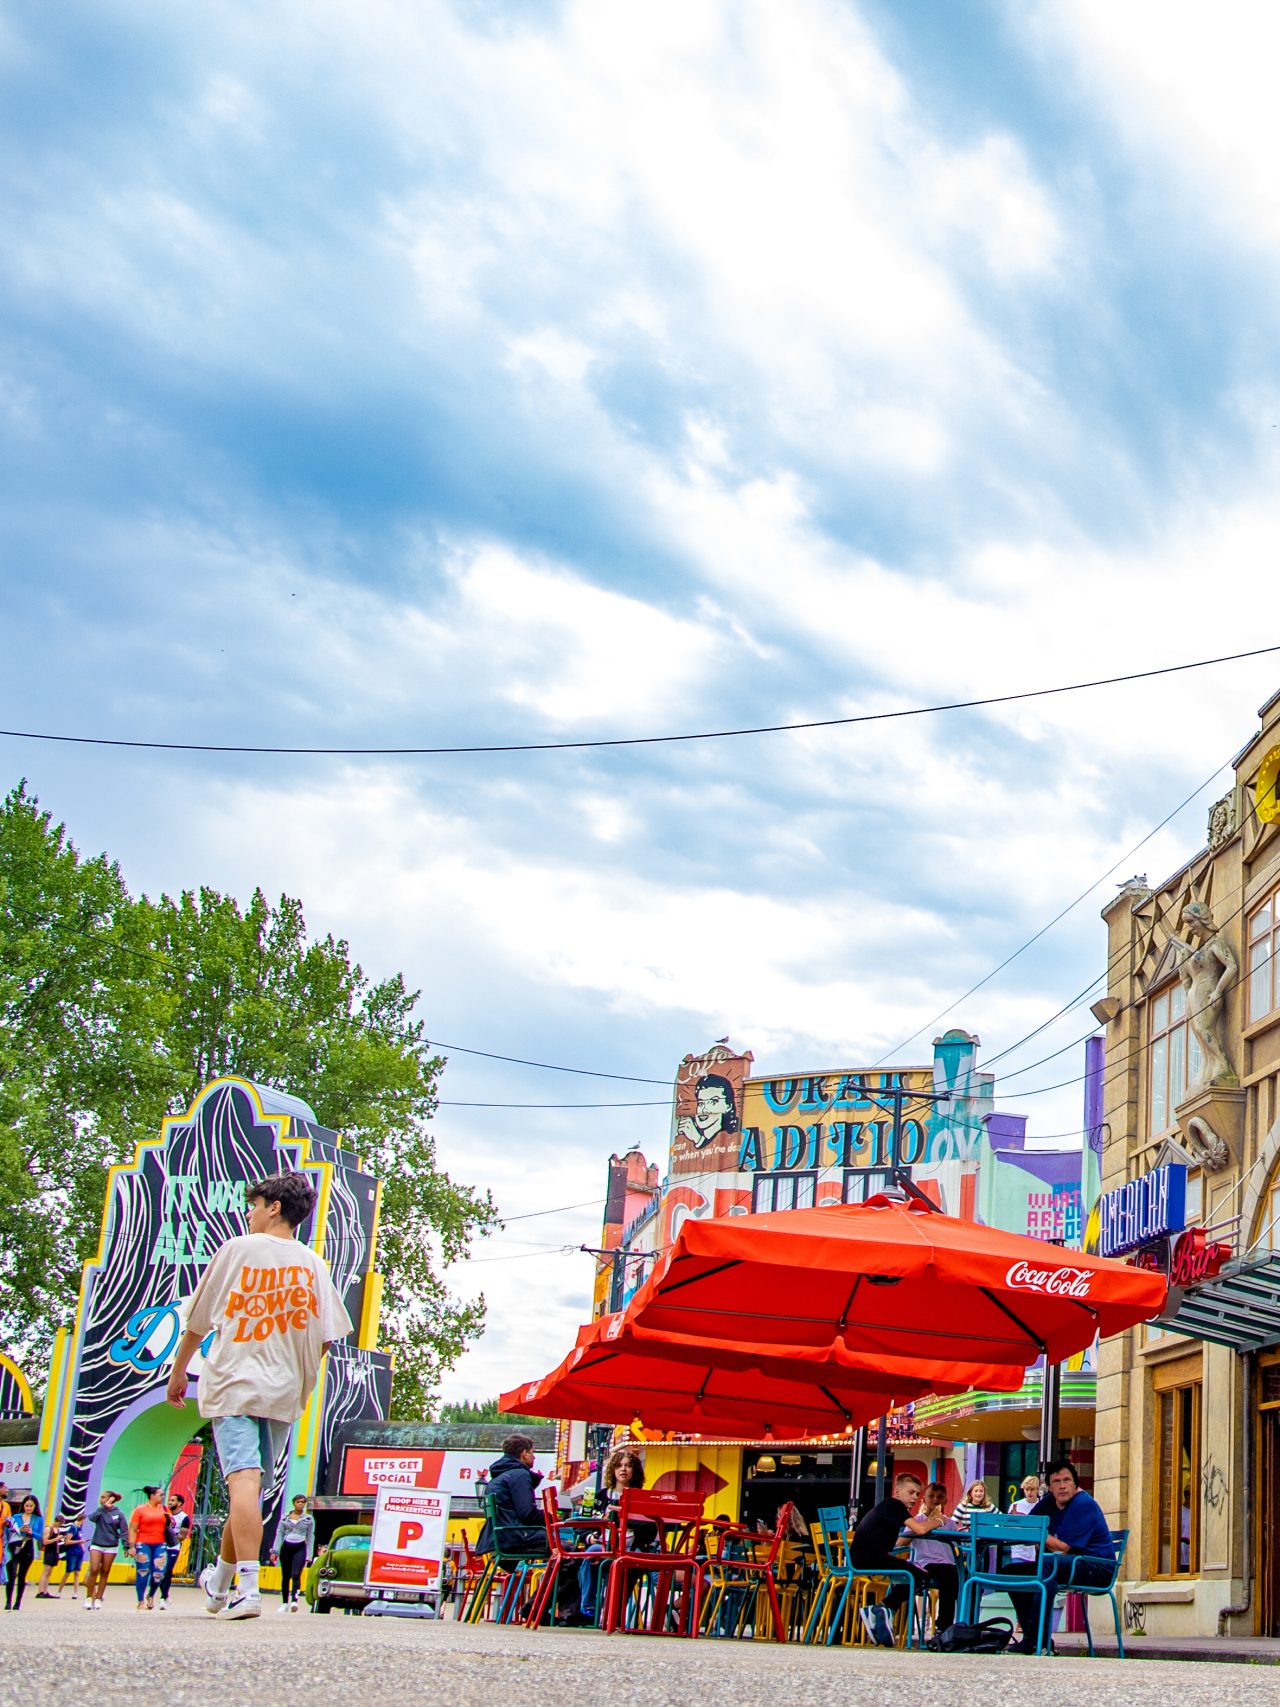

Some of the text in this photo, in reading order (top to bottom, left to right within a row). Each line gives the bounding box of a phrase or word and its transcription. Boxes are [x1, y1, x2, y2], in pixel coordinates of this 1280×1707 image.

[166, 1175, 247, 1214] IT WA
[1028, 1190, 1081, 1208] WHAT
[1100, 1165, 1170, 1257] AMERICAN
[1027, 1210, 1064, 1227] ARE
[150, 1221, 212, 1265] ALL
[1169, 1229, 1220, 1287] Bar
[1005, 1261, 1096, 1297] Coca-Cola
[368, 1461, 419, 1470] LET'S GET
[397, 1521, 424, 1549] P
